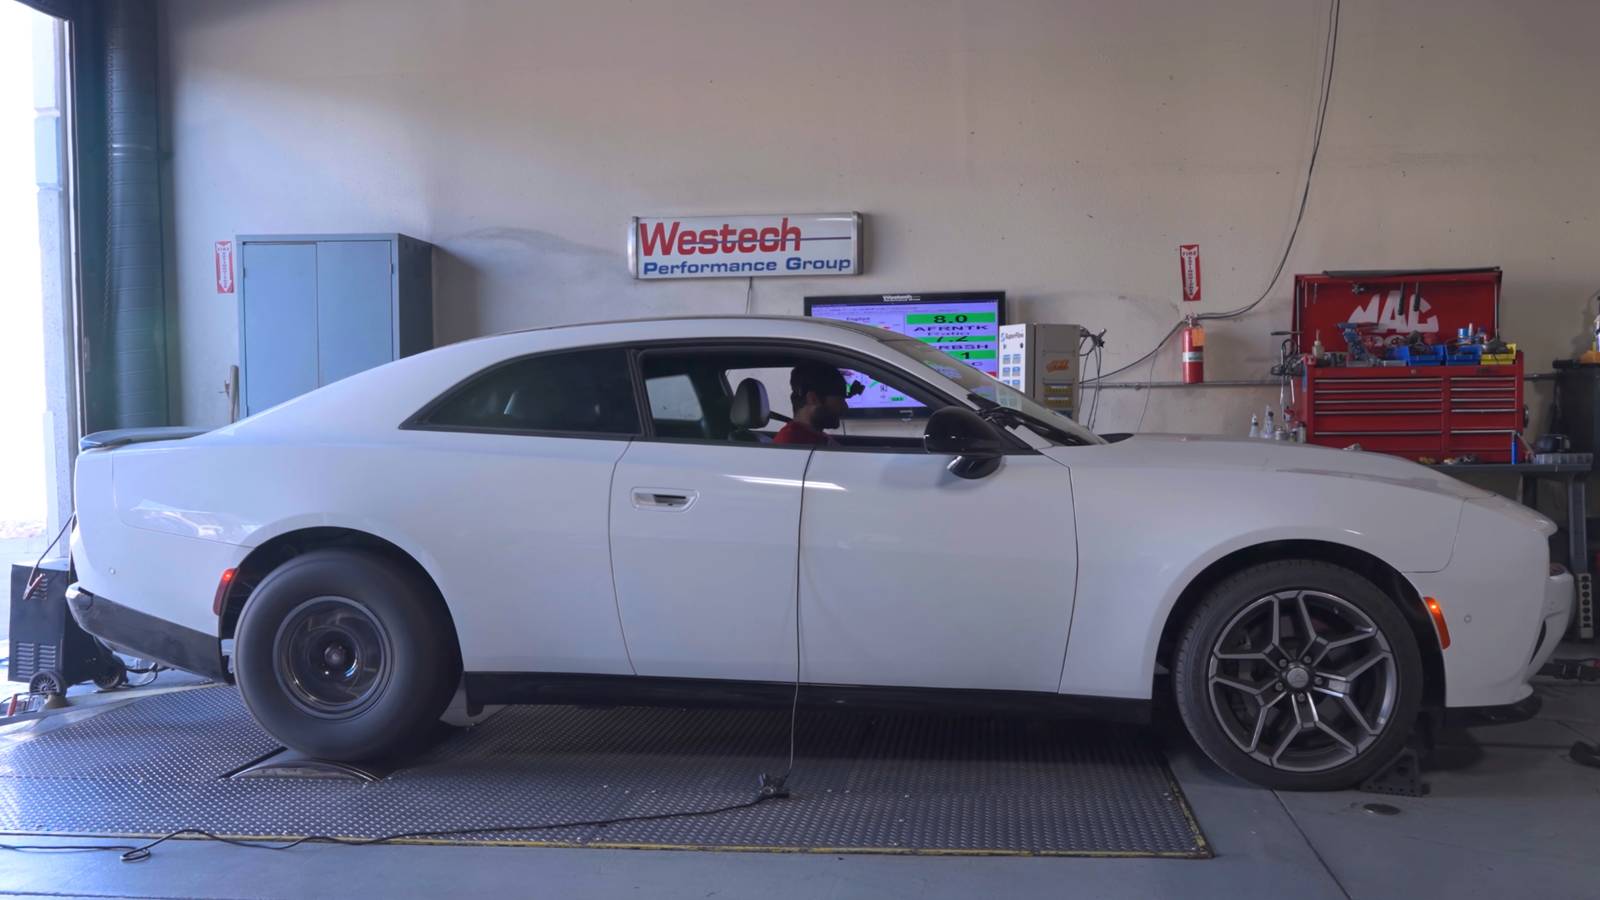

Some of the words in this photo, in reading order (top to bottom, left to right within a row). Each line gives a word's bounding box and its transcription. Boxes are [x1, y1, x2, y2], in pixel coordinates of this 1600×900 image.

[640, 217, 801, 256] Westech
[643, 260, 777, 275] Performance
[785, 256, 851, 273] Group
[933, 315, 968, 324] 8.0
[1347, 289, 1440, 333] MAC
